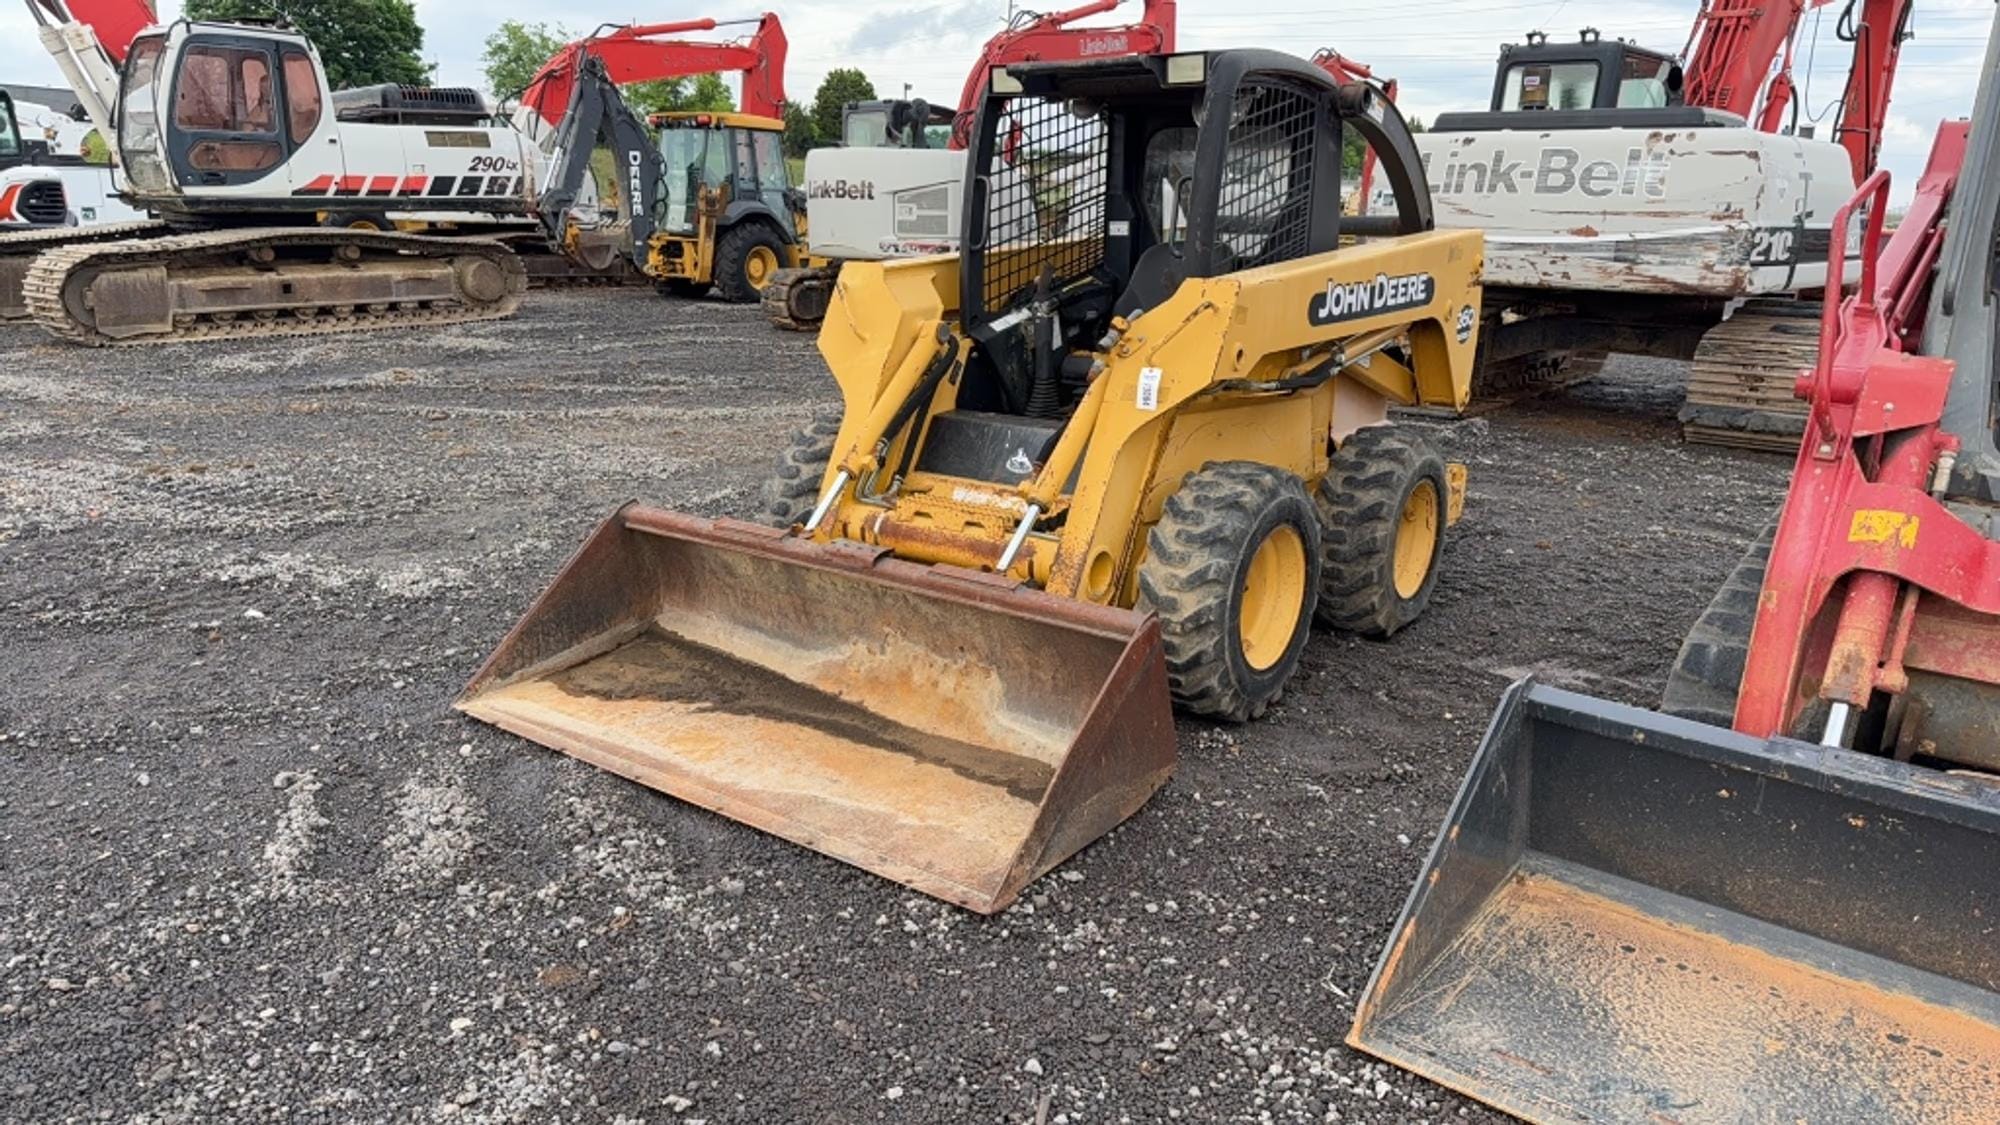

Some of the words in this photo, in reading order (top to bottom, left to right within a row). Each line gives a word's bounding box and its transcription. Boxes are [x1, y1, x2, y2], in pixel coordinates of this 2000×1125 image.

[468, 156, 505, 173] 290
[628, 150, 645, 216] DEERE
[1422, 148, 1669, 198] Link-Belt
[808, 179, 875, 200] Link-Belt
[1318, 279, 1371, 319] JOHN
[1373, 272, 1429, 309] DEERE
